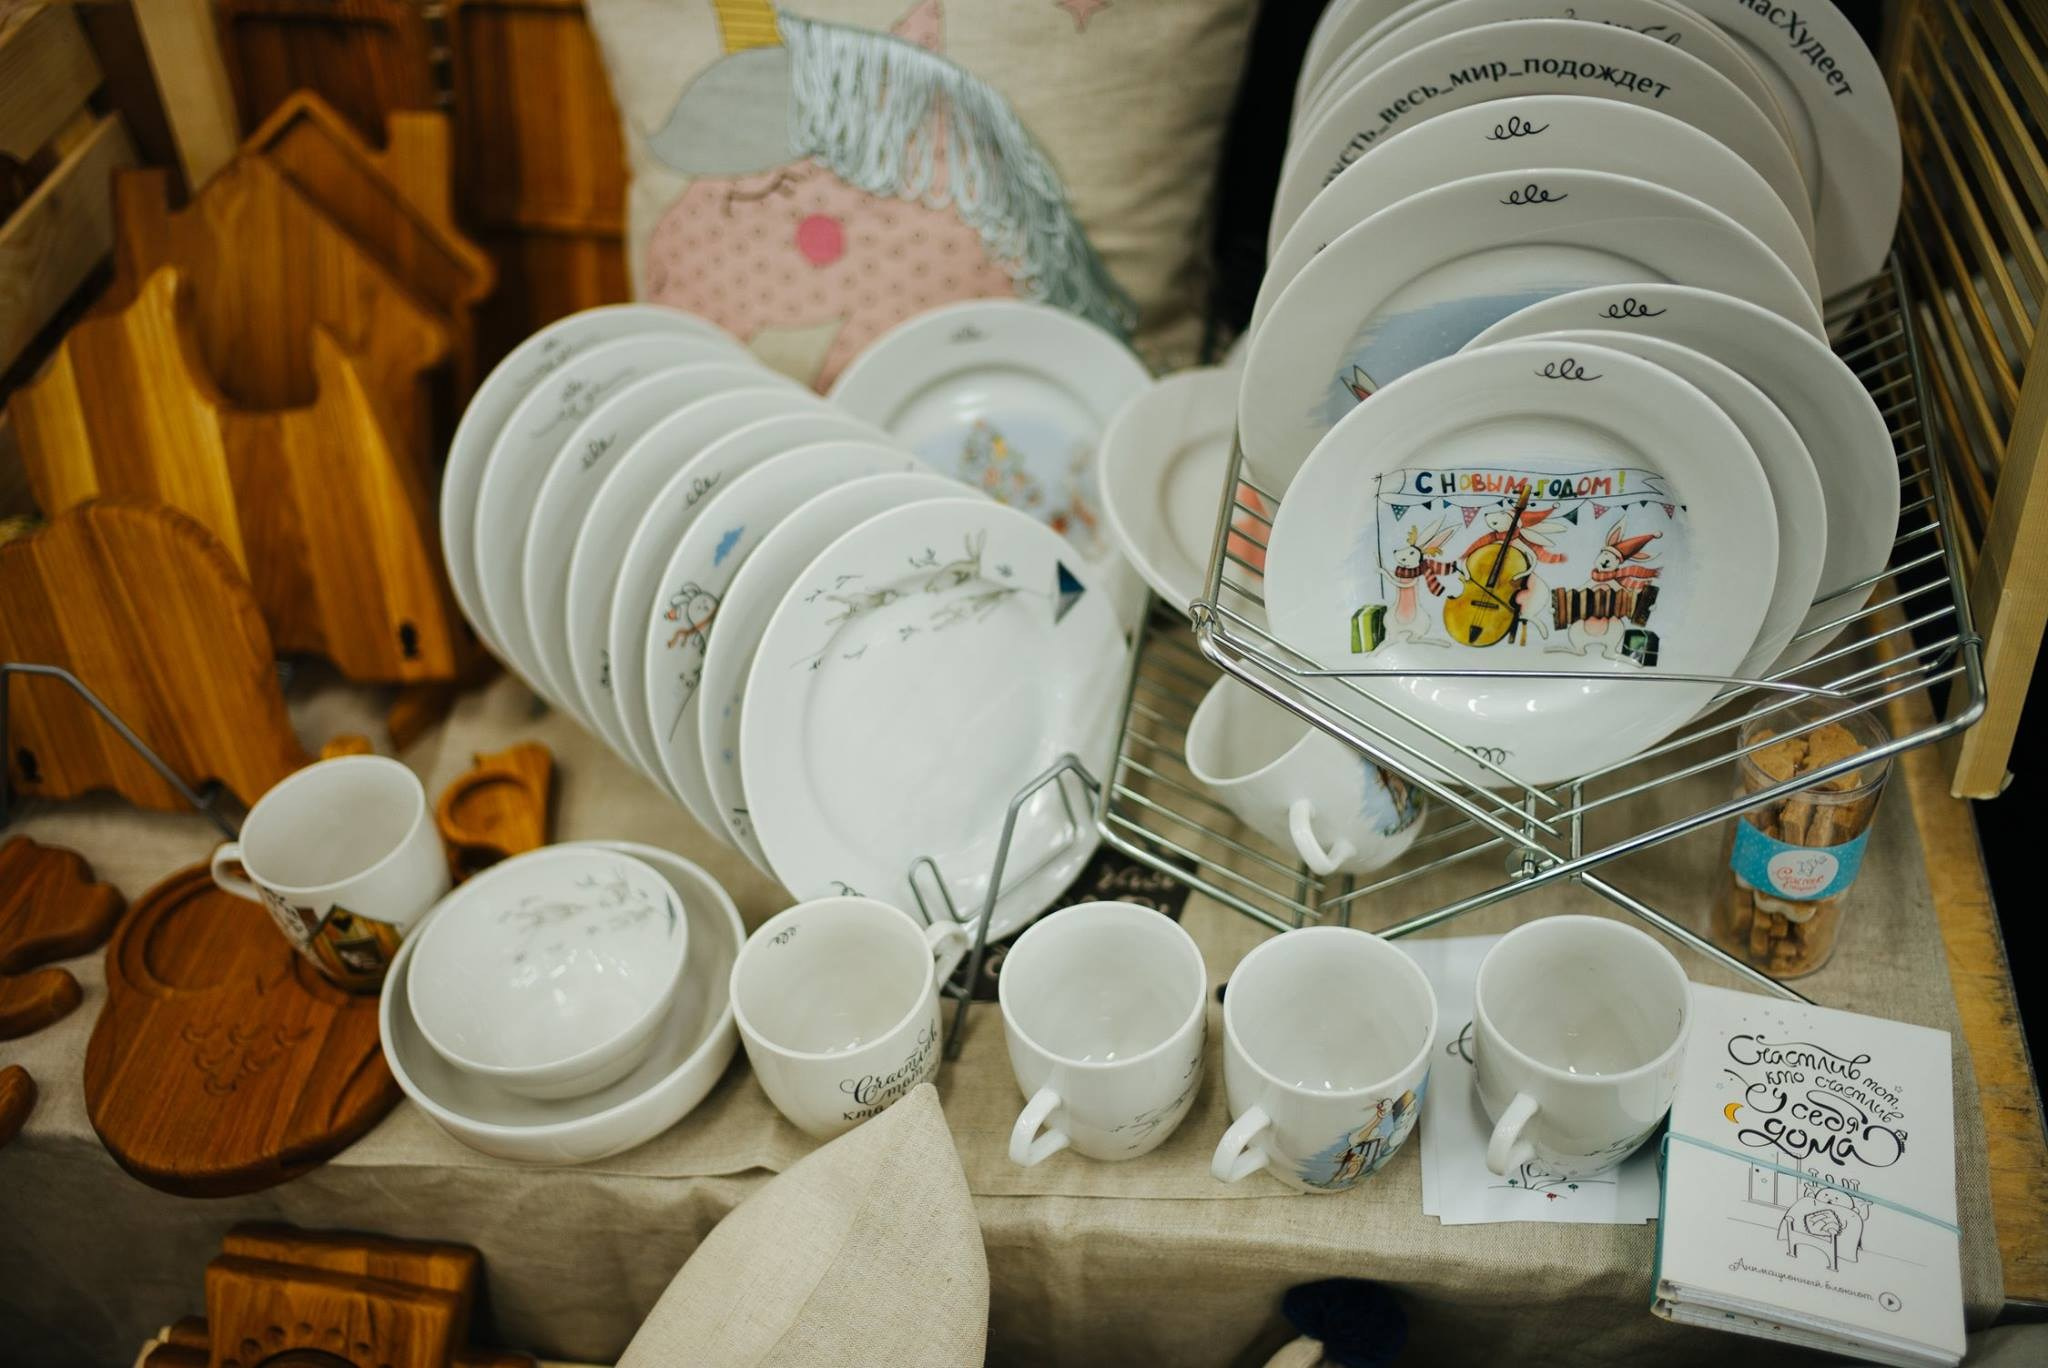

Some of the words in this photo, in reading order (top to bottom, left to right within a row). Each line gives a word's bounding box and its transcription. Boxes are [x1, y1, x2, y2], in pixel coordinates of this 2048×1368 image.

[1414, 471, 1433, 494] С
[1440, 472, 1529, 494] НОВЫМ
[1728, 1034, 1871, 1080] Счастлив
[1765, 1071, 1805, 1086] кто
[1815, 1075, 1905, 1123] счастлив
[1737, 1117, 1903, 1168] дома
